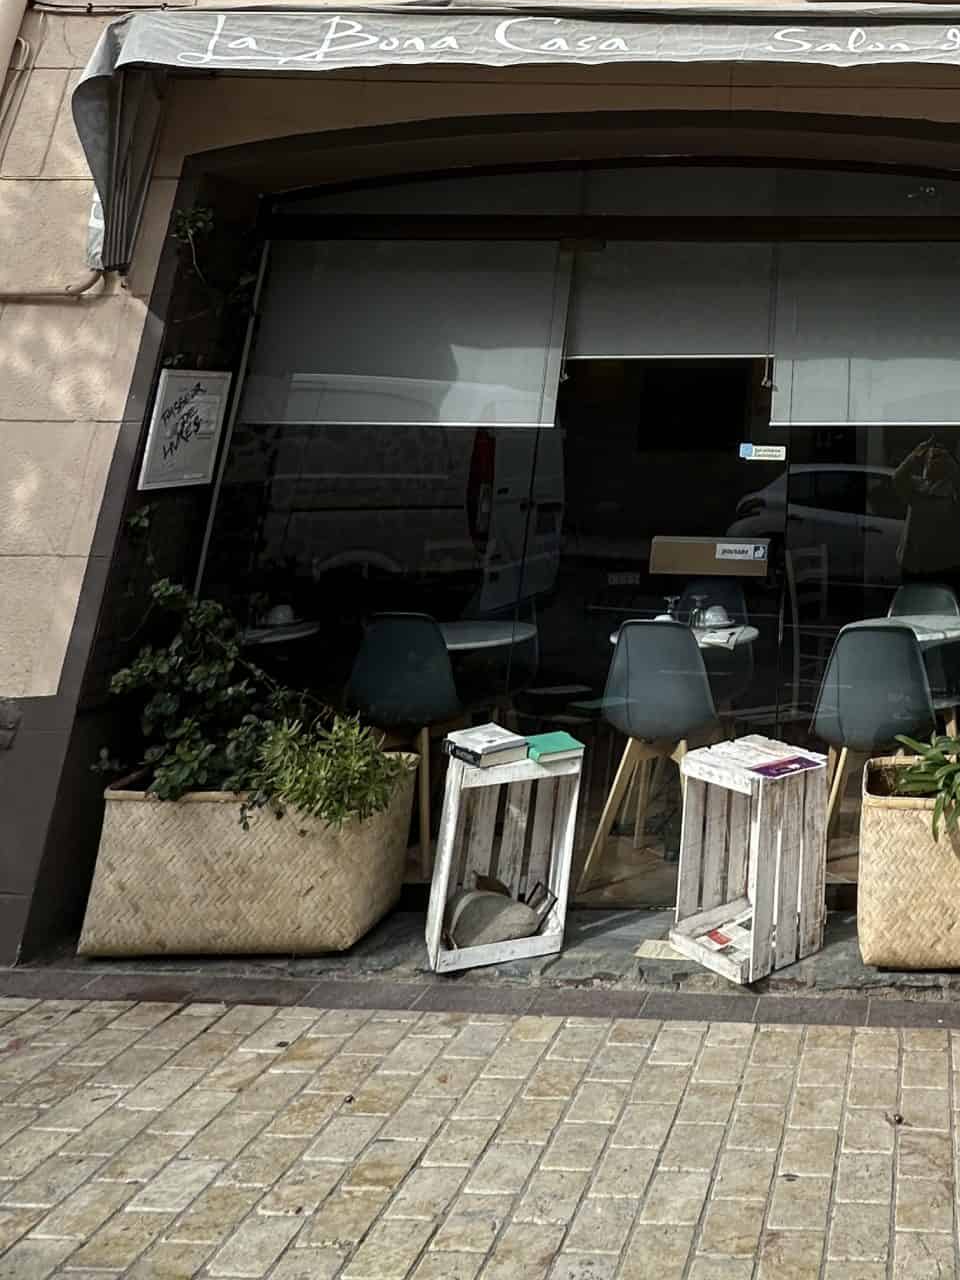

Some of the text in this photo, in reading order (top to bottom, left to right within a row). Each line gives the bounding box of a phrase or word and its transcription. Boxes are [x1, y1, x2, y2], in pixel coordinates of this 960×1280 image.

[176, 14, 258, 64] La
[278, 15, 459, 64] Bona
[495, 16, 629, 57] Casa
[766, 27, 911, 53] Salon
